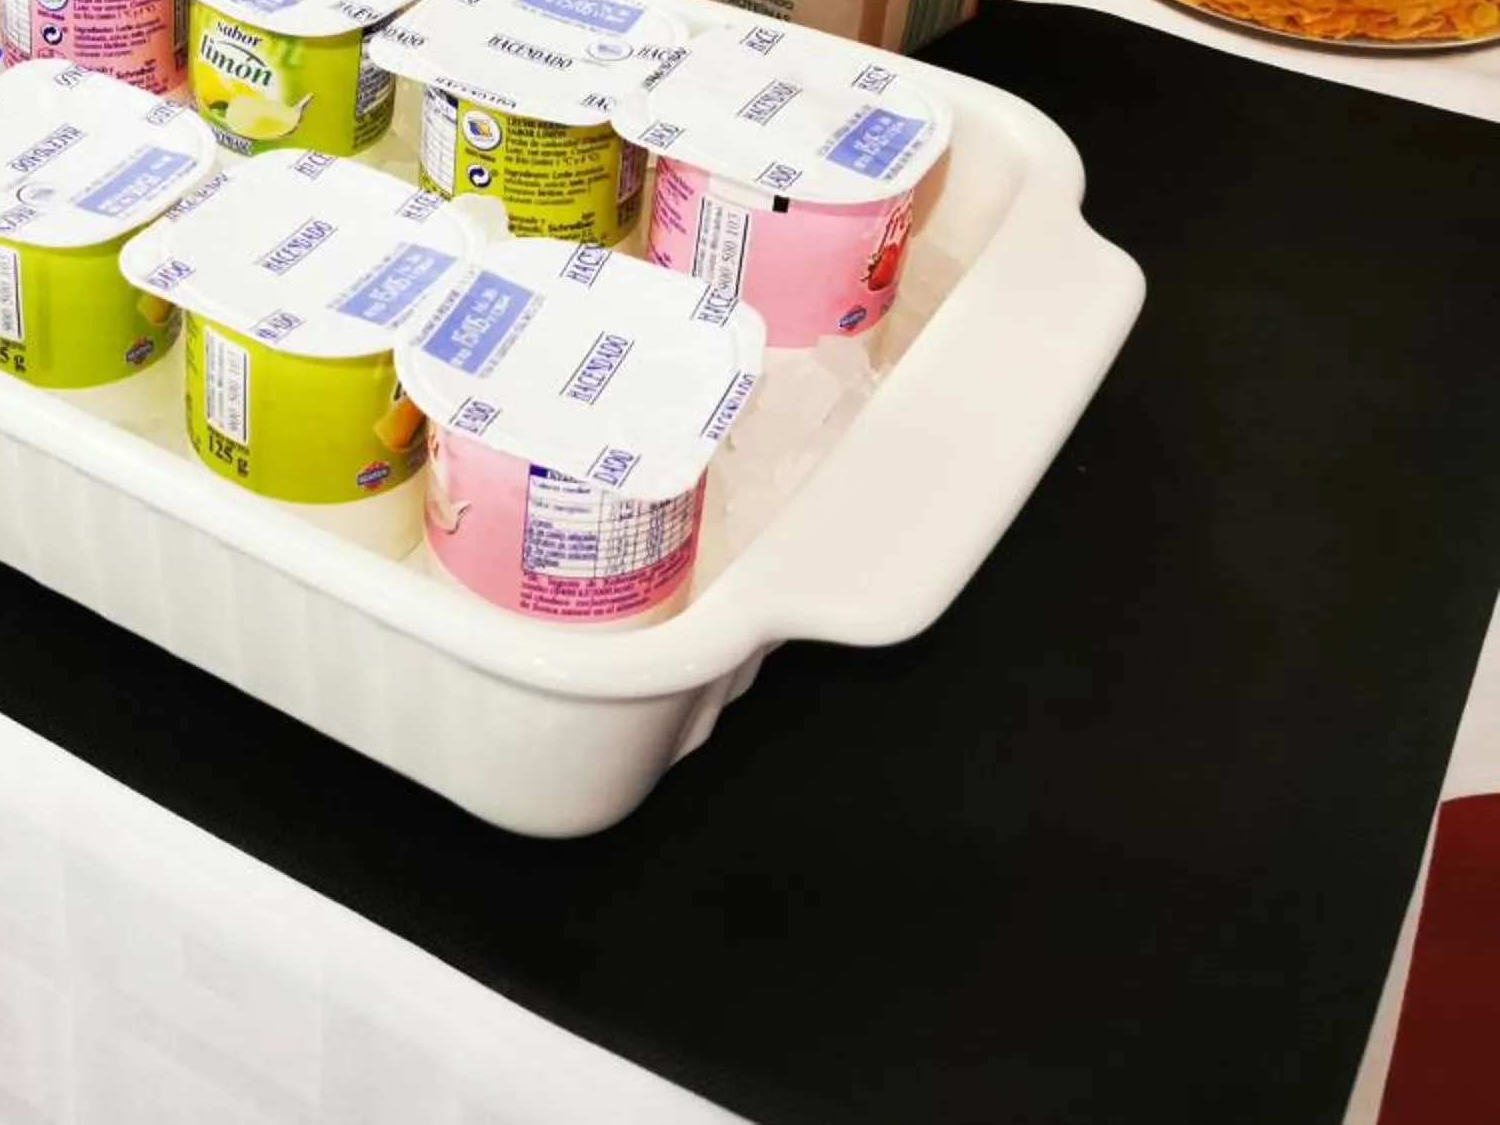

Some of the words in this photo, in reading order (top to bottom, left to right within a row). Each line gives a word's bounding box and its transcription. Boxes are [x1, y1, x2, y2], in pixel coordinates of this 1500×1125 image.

[216, 21, 263, 48] sabor
[200, 33, 273, 87] limón
[13, 354, 26, 373] g
[570, 334, 630, 402] HACENDADO
[207, 433, 233, 464] 125
[237, 457, 249, 477] g
